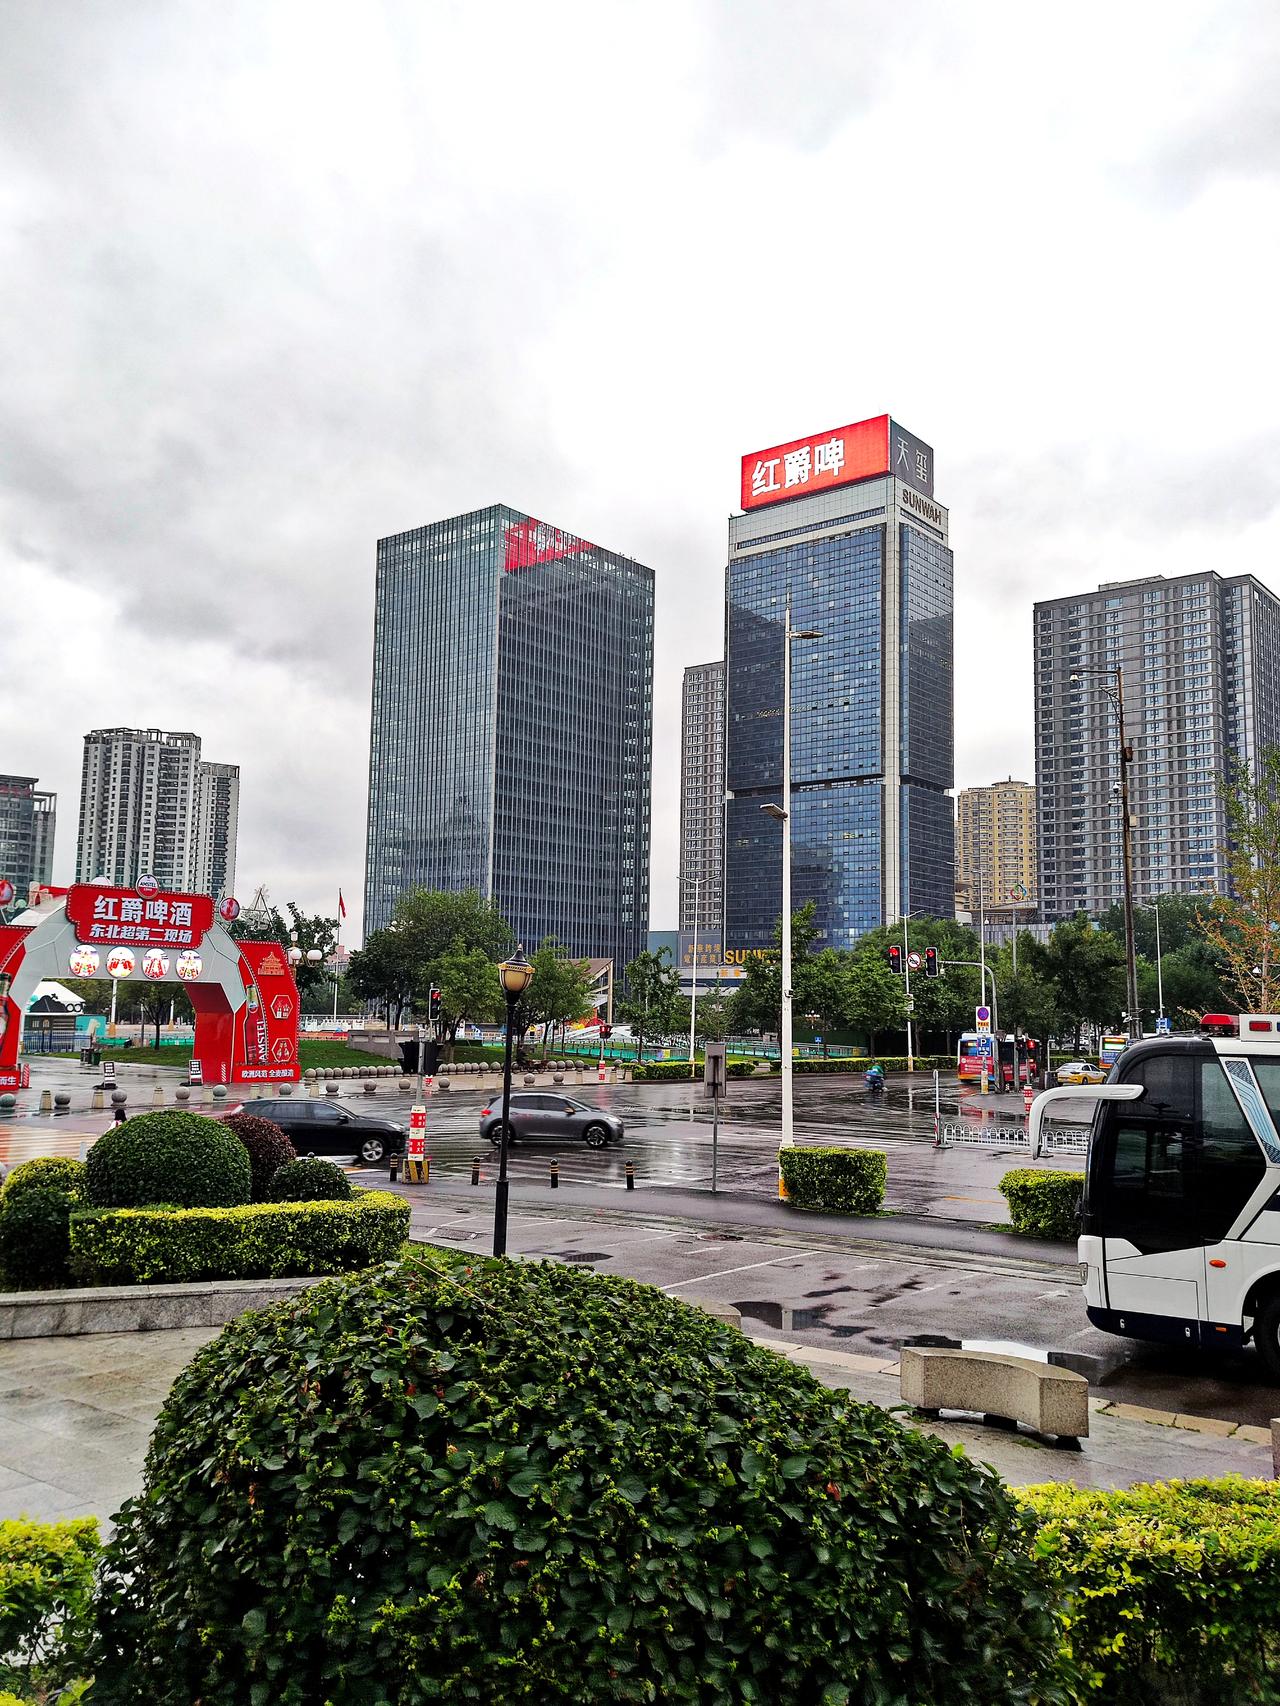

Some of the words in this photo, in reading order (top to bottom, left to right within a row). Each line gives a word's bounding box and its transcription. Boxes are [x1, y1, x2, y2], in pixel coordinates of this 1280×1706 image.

[751, 437, 846, 497] 红爵啤
[902, 488, 942, 526] SUNWAH
[93, 894, 193, 927] 红爵啤酒
[89, 923, 193, 943] 东北超第二现场
